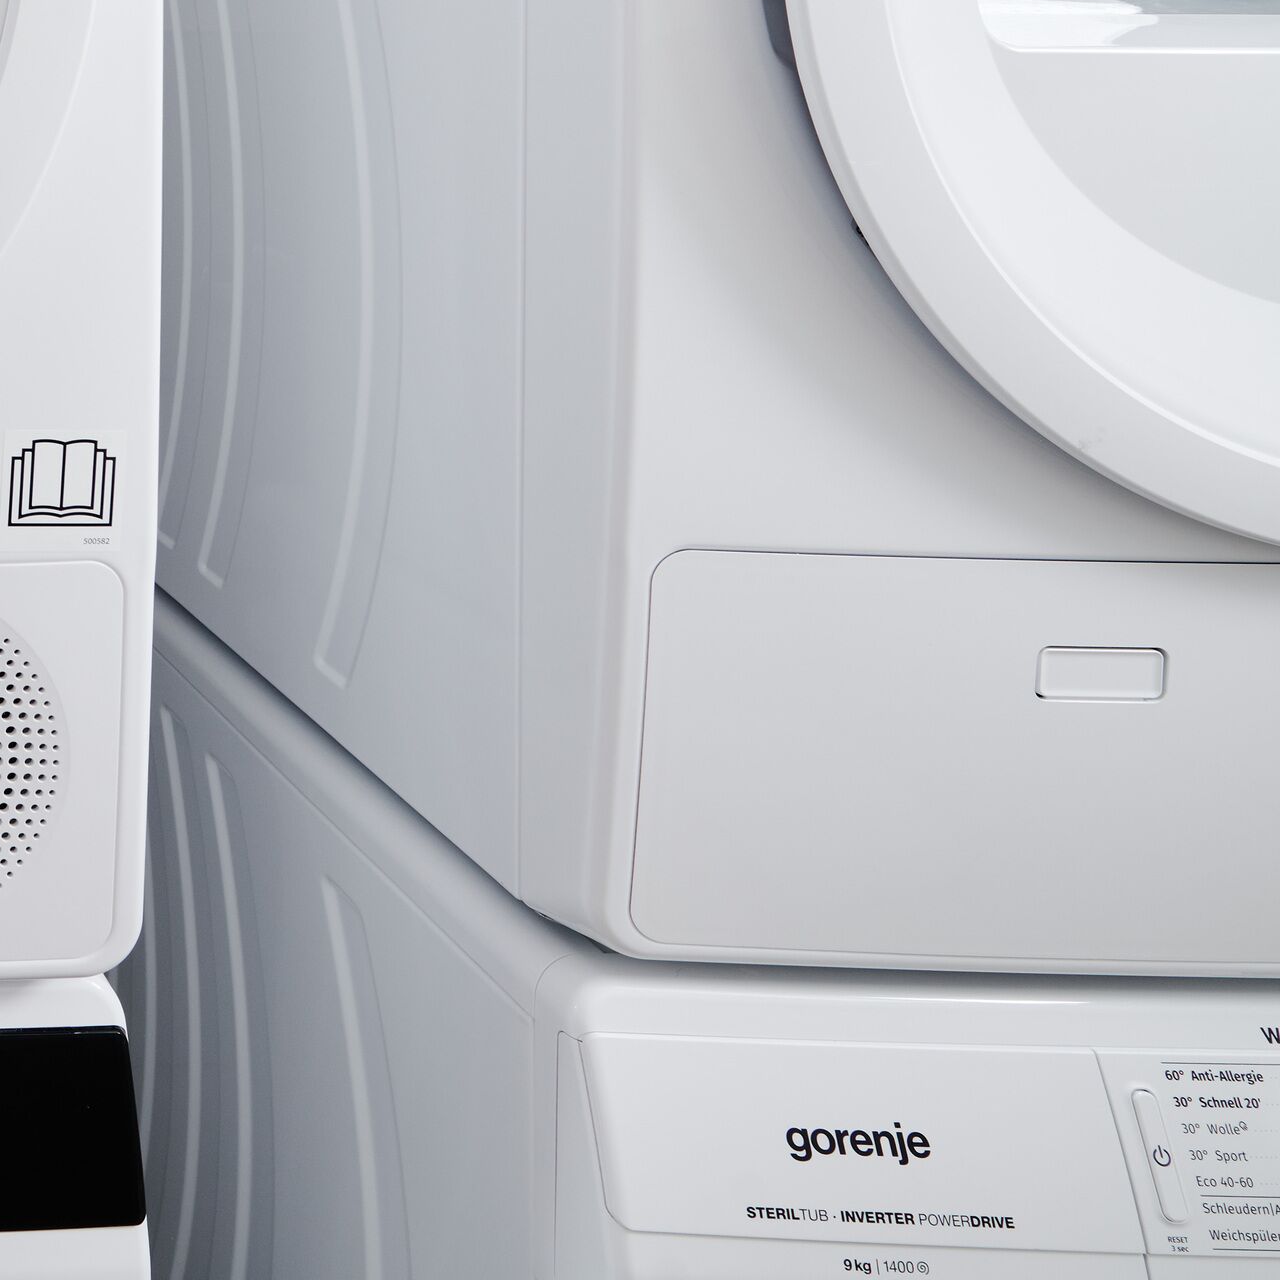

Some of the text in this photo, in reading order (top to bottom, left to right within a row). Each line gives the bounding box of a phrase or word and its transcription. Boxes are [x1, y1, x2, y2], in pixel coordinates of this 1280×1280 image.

[1164, 1070, 1264, 1085] 60° Anti-Allergie
[1173, 1097, 1261, 1109] 30° Schnell 20'
[1181, 1123, 1240, 1135] 30° Wolle
[785, 1122, 931, 1165] gorenje
[1188, 1150, 1249, 1164] 30° Sport
[1196, 1176, 1254, 1189] Eco 40-60
[746, 1206, 1015, 1229] STERILTUB INVERTER POWERDRIVE
[1167, 1236, 1189, 1244] RESET
[883, 1260, 915, 1274] 1400
